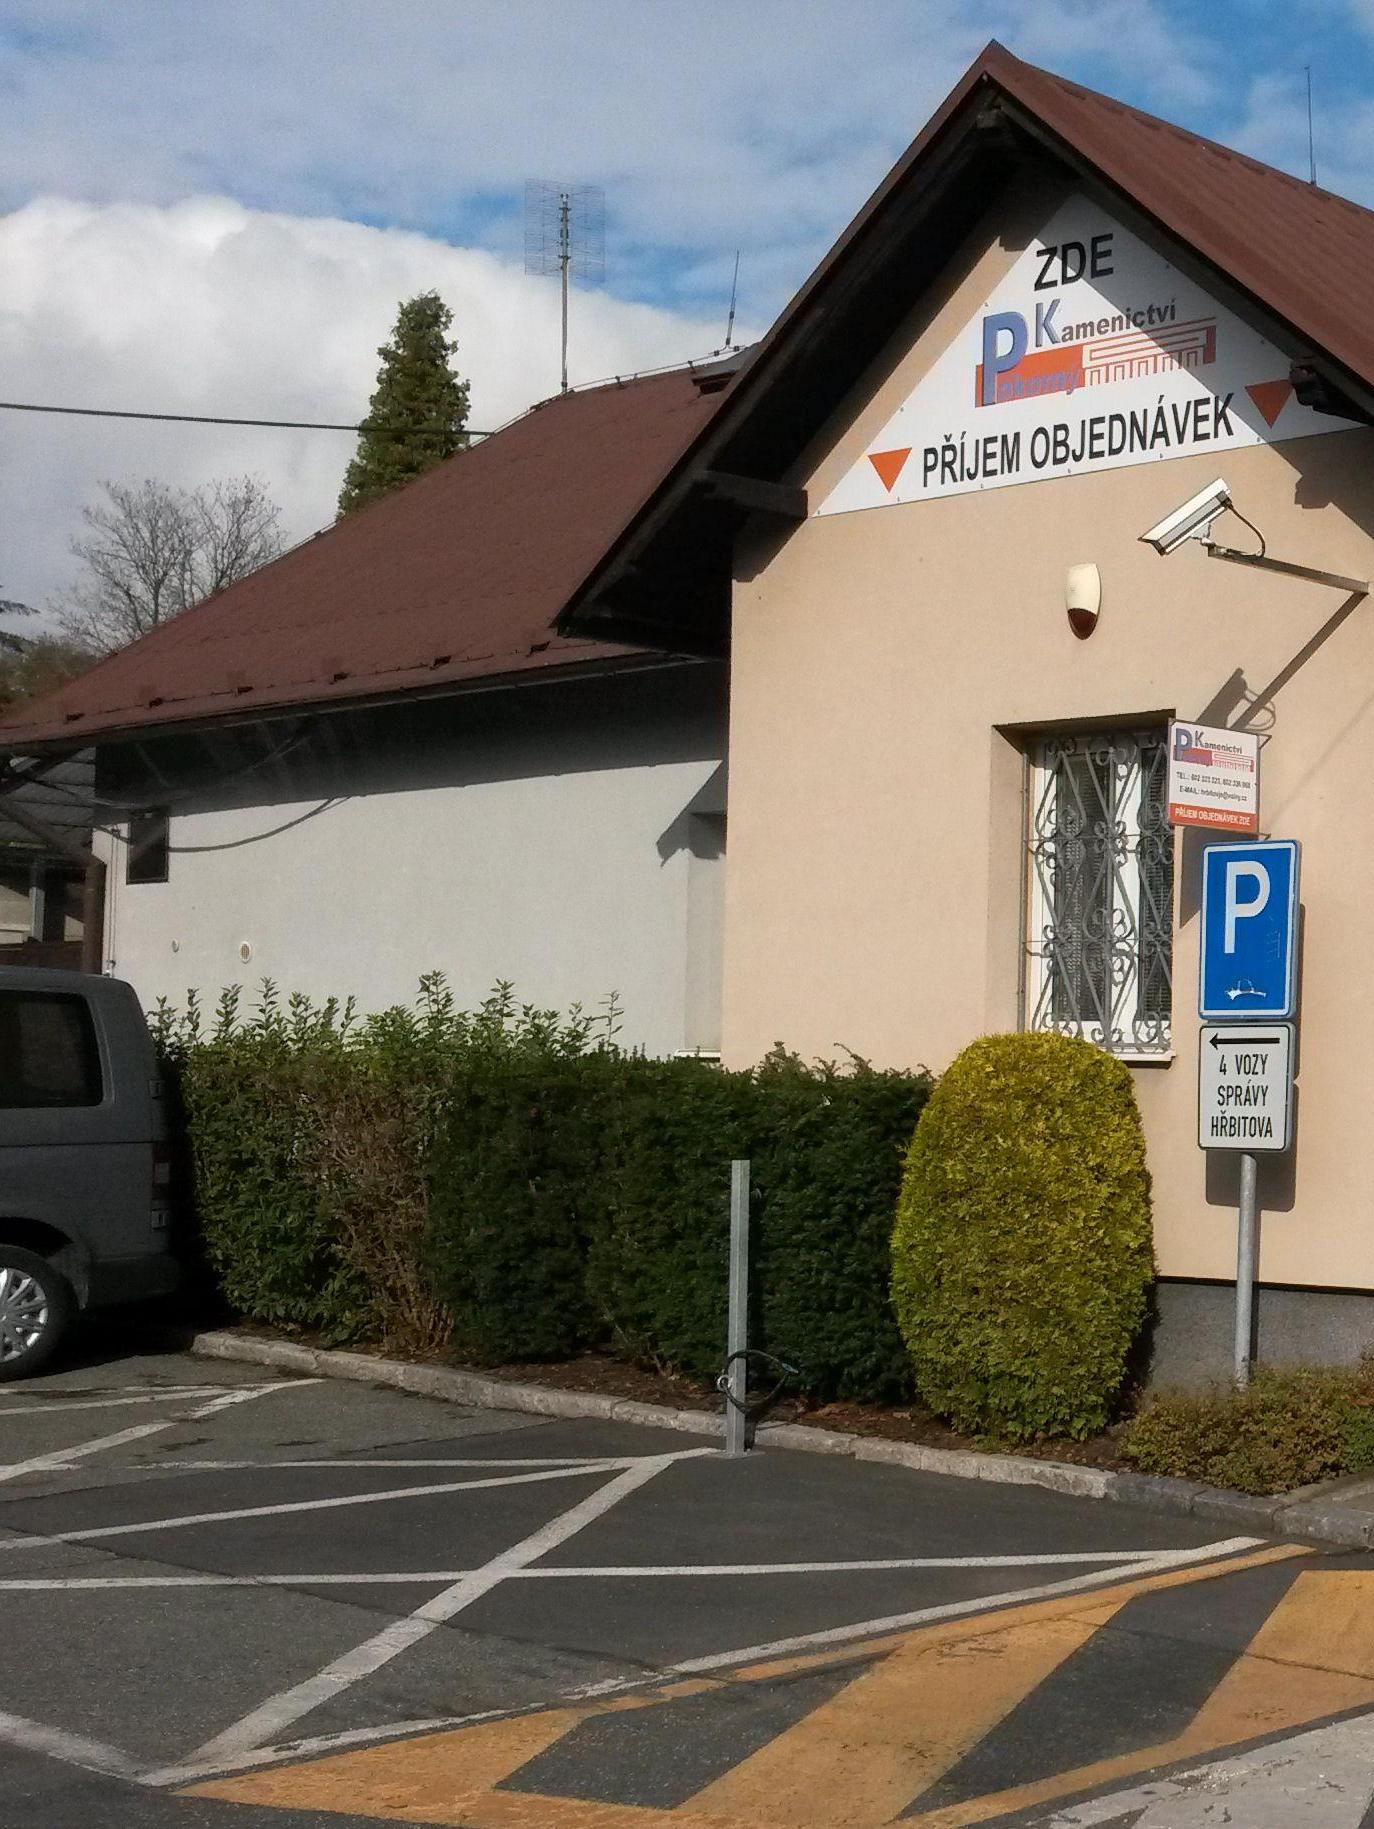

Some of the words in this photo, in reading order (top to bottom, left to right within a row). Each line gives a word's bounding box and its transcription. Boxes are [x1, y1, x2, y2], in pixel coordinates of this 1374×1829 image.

[1034, 233, 1114, 291] ZDE
[1035, 298, 1176, 347] Kamenictví
[923, 431, 1020, 488] PŘÍJEM
[1030, 392, 1234, 469] OBJEDNÁVEK
[1224, 860, 1270, 954] P
[1219, 1054, 1227, 1076] 4
[1235, 1053, 1269, 1076] VOZY
[1217, 1079, 1269, 1106] SPRÁVY
[1211, 1109, 1273, 1138] HŘBITOVA
